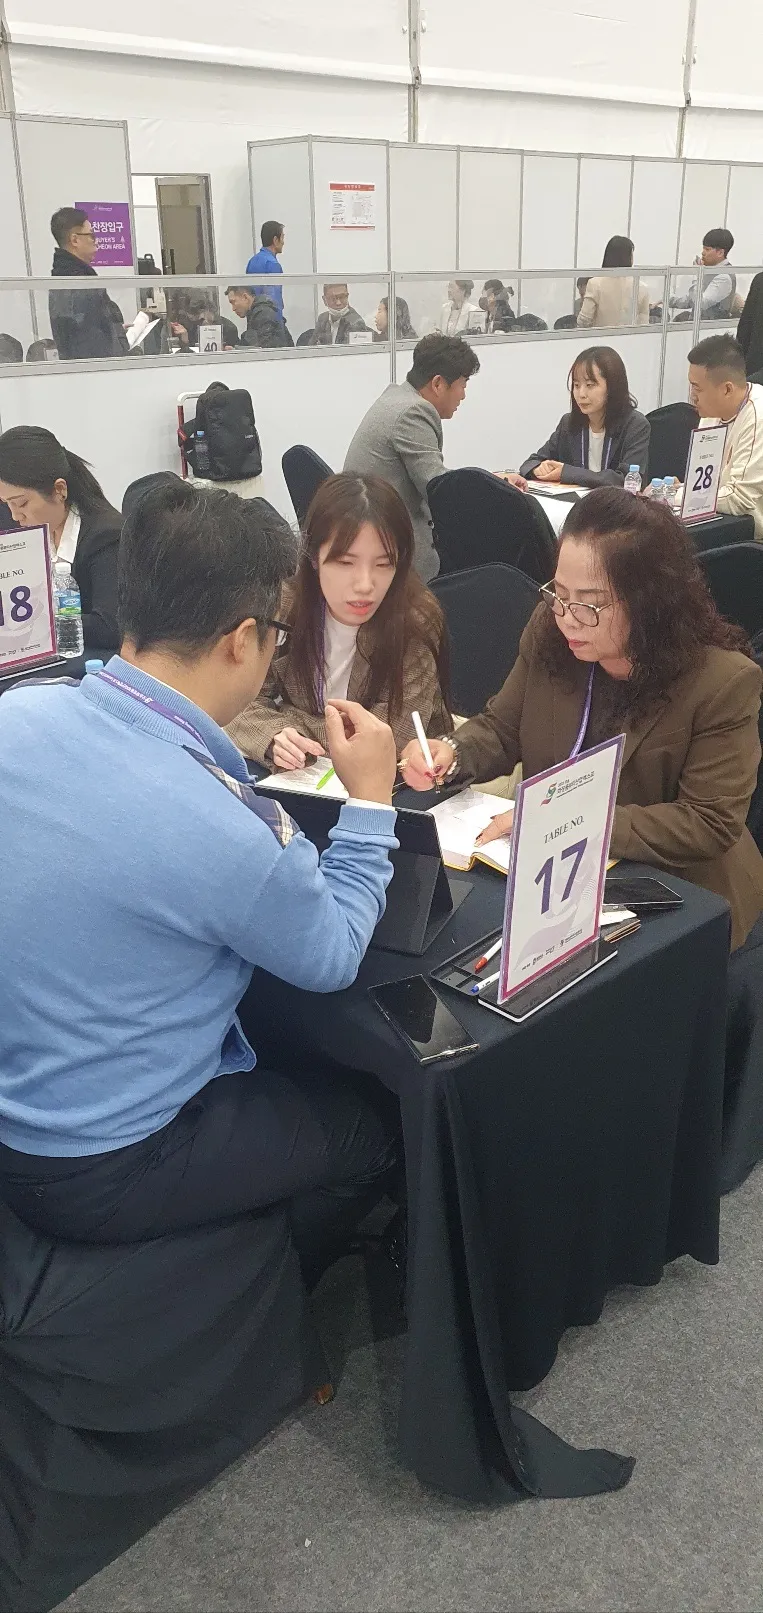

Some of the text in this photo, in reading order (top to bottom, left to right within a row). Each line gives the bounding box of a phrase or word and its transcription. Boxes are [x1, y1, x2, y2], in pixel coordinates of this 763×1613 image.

[91, 221, 124, 233] 찬장입구
[692, 464, 714, 492] 28
[543, 822, 569, 844] TABLE
[534, 836, 588, 915] 17
